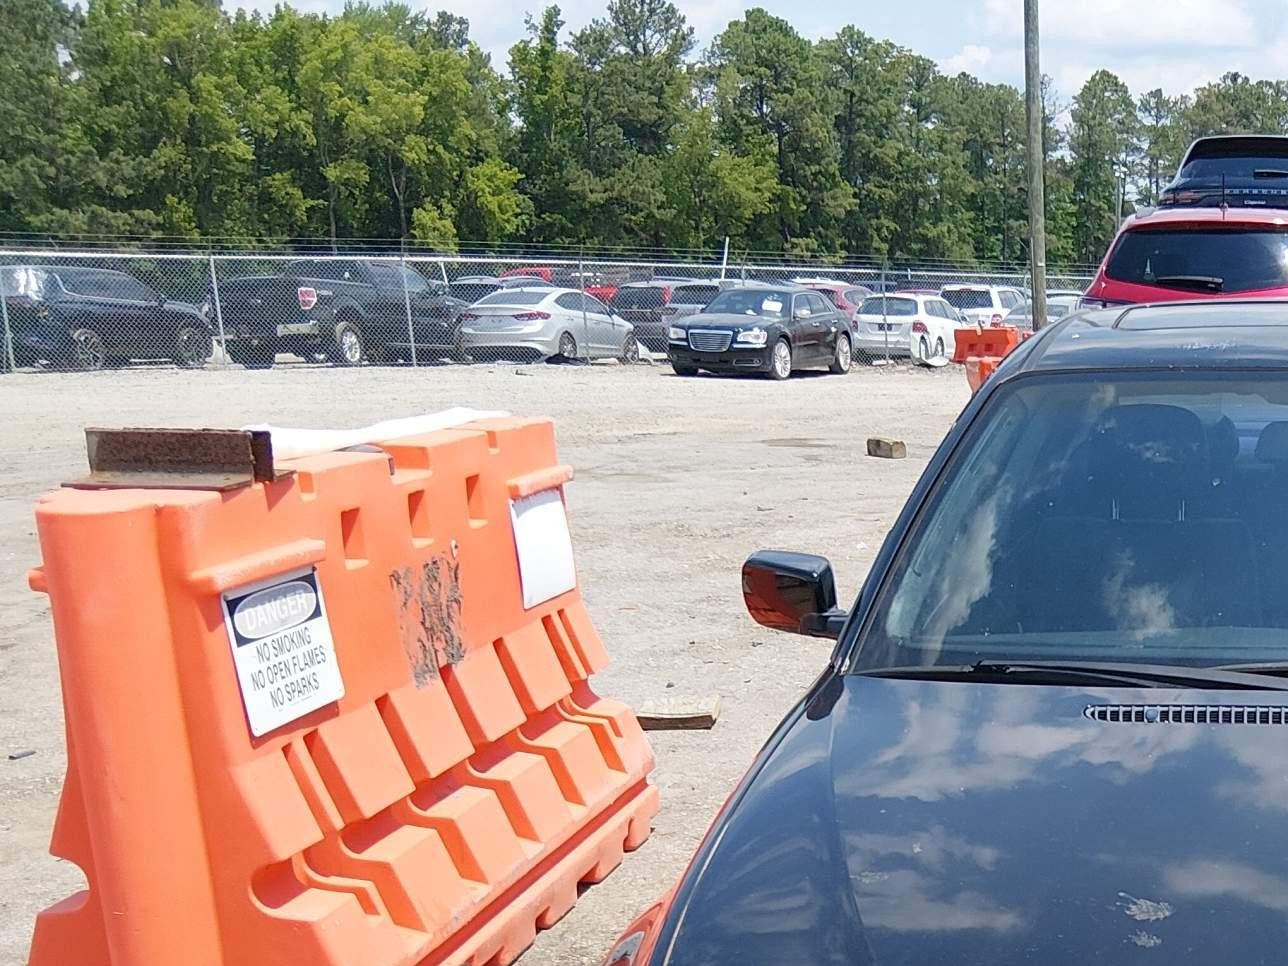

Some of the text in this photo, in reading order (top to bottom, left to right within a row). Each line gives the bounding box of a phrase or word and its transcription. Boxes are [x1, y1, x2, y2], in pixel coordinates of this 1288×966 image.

[244, 590, 310, 631] DANGER
[255, 627, 312, 664] NO SMOKING
[250, 645, 327, 692] NO OPEN FLAMES
[269, 689, 285, 709] NO
[285, 672, 320, 703] SPARKS
